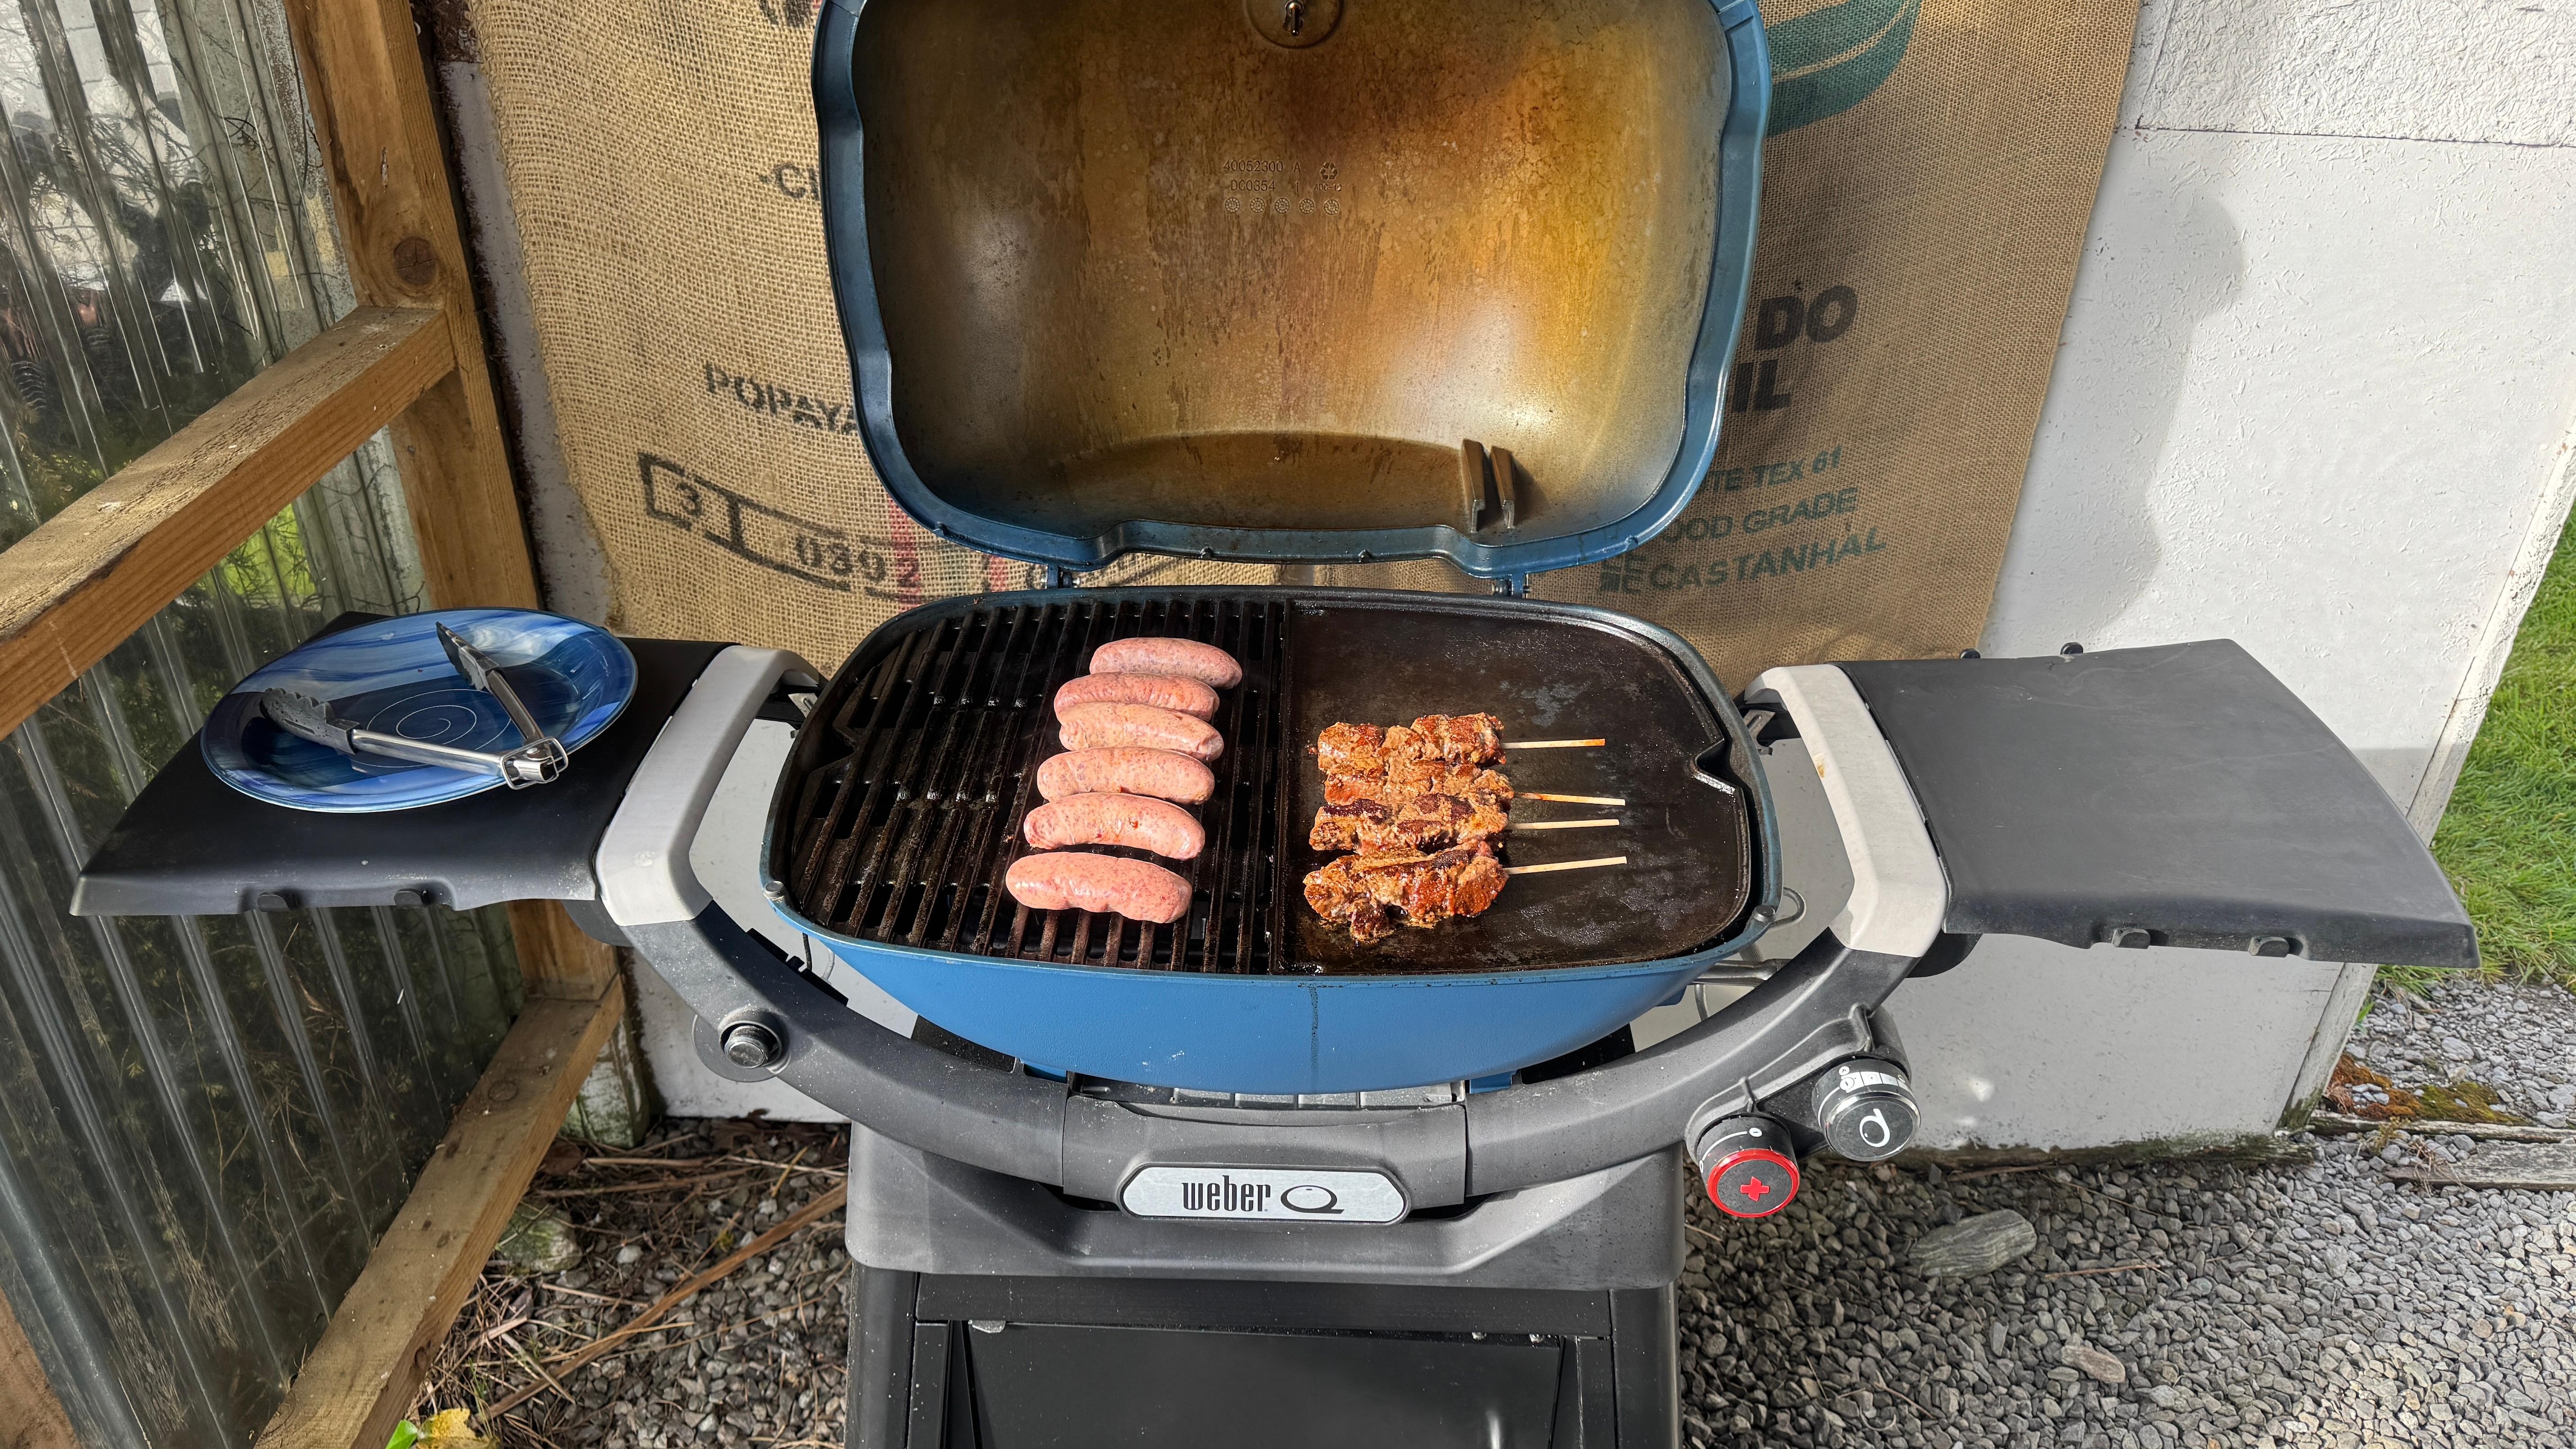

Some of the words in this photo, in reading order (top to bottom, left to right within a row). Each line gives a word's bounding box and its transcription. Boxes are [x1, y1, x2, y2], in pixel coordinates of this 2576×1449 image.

[1223, 160, 1283, 172] 40052300
[1293, 161, 1301, 173] A
[1754, 285, 1858, 351] DO
[1753, 458, 1806, 489] TEX
[1811, 445, 1842, 474] 61
[1743, 487, 1859, 534] GRADE
[1651, 525, 1887, 591] CASTANHAL
[1181, 1175, 1271, 1212] weber
